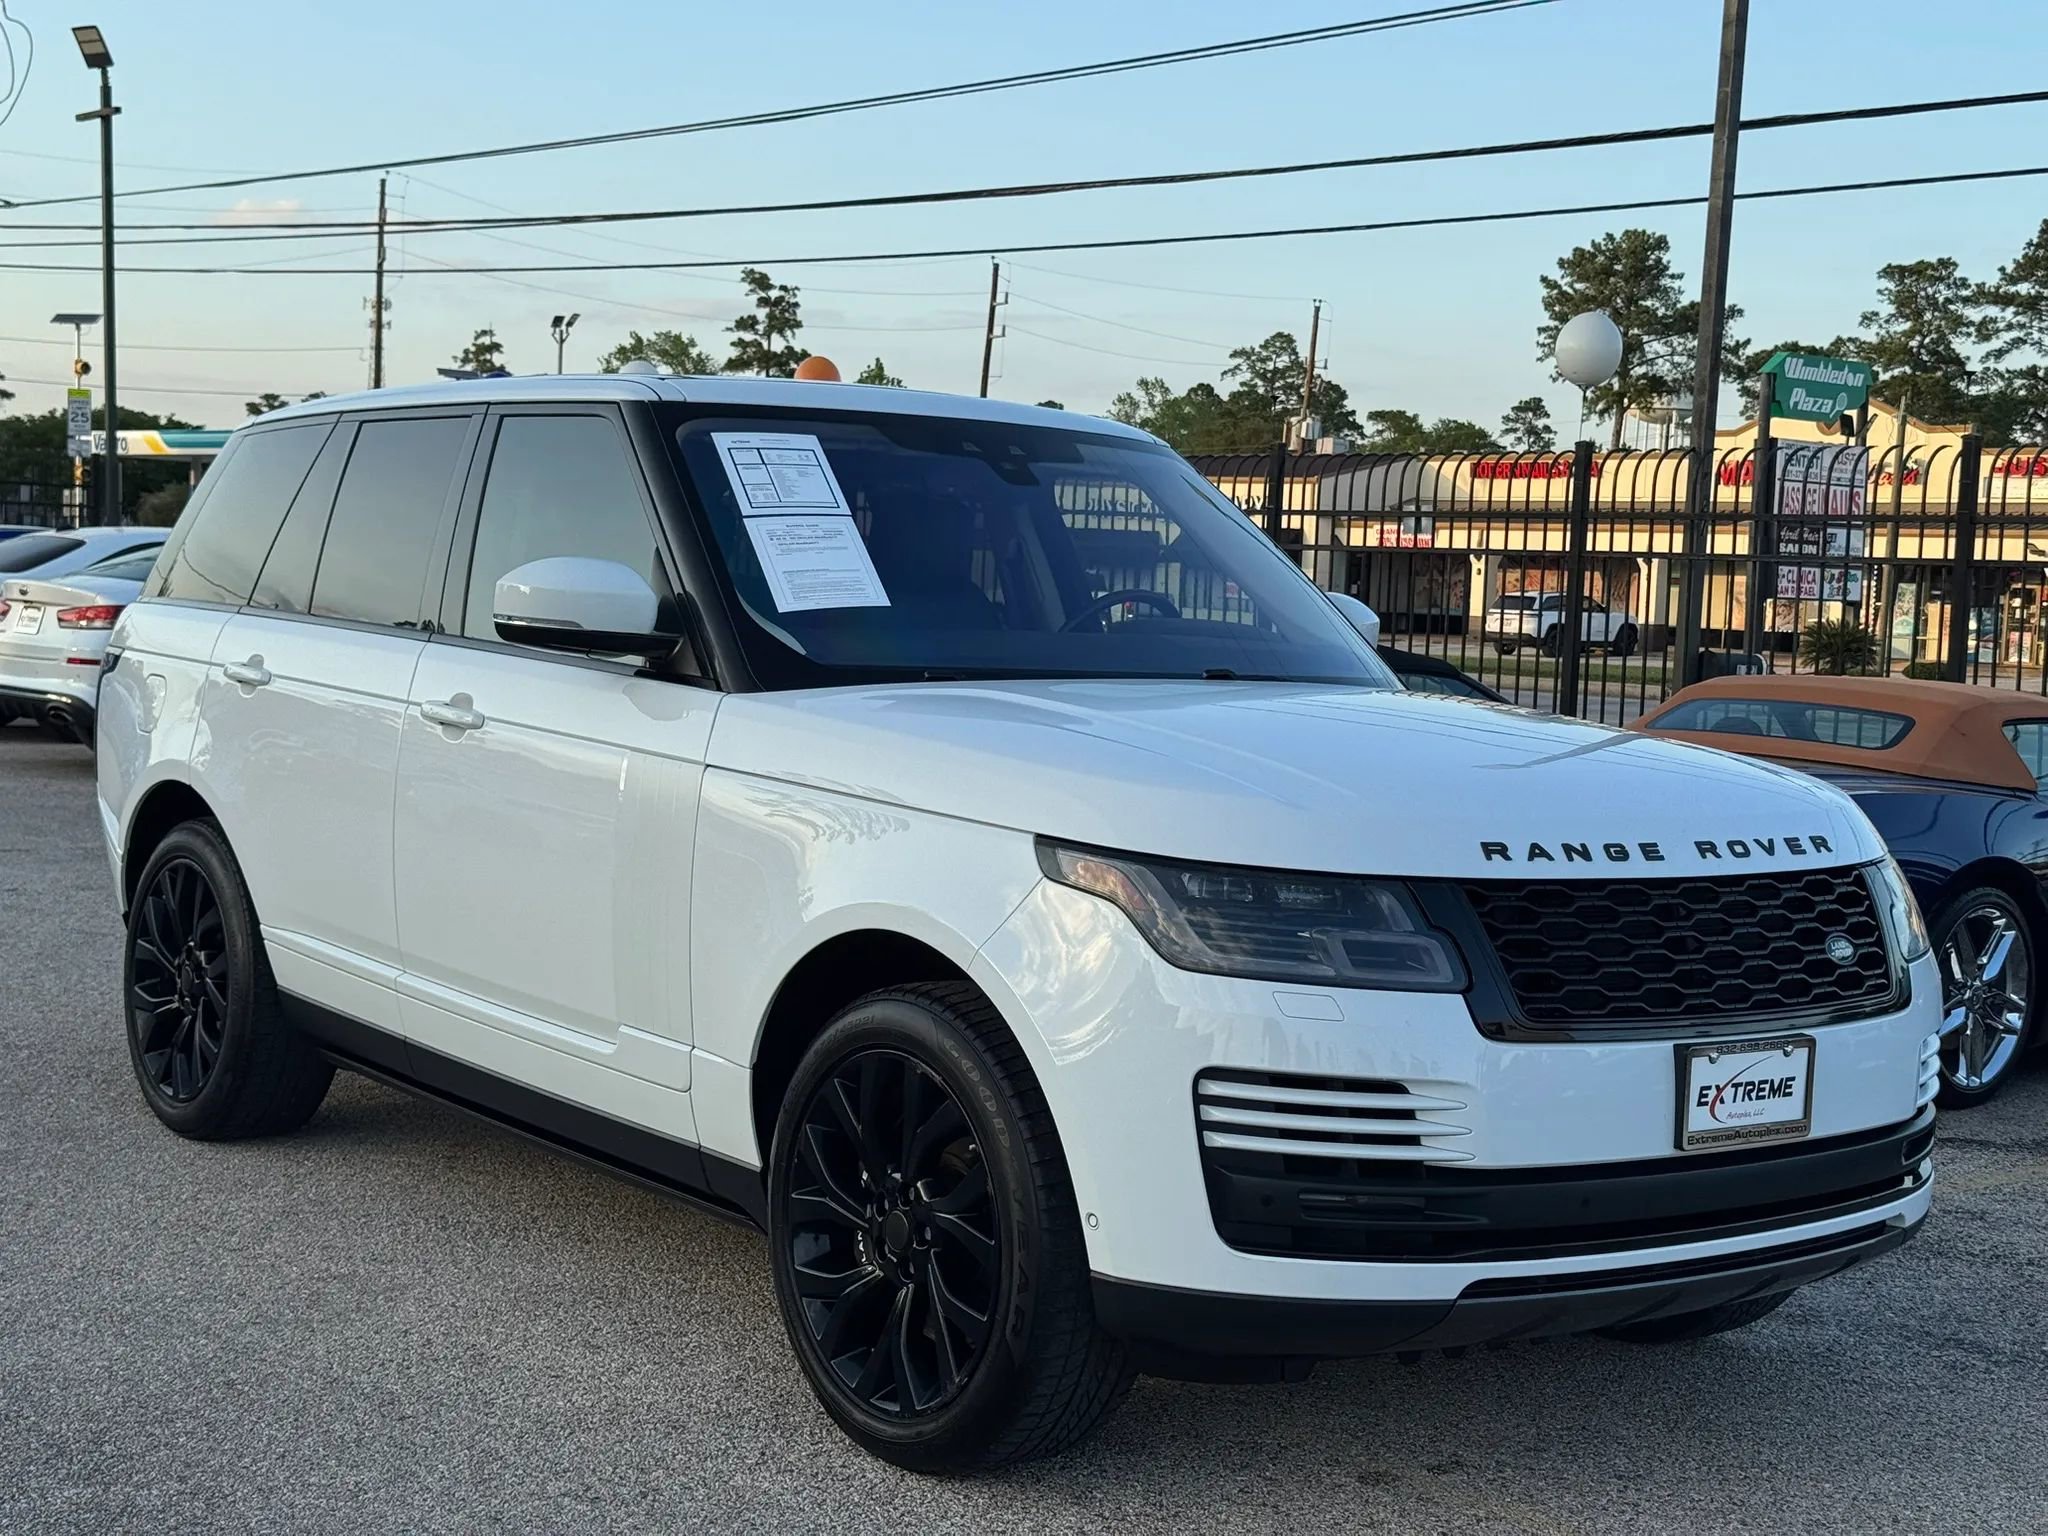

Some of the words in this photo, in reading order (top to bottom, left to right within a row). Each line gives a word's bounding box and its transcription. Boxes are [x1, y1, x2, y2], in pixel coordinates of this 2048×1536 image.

[1784, 357, 1865, 387] Wimbledon
[1790, 387, 1833, 413] Plaza
[71, 411, 90, 423] 25
[93, 434, 128, 452] Varo
[1786, 569, 1816, 585] CLNICA
[1791, 585, 1816, 598] RFAEL
[1480, 841, 1666, 862] RANGE
[1694, 835, 1834, 859] ROVER
[1696, 1076, 1797, 1107] EXTREME
[1688, 1124, 1808, 1146] ExtremeAutoplex.com
